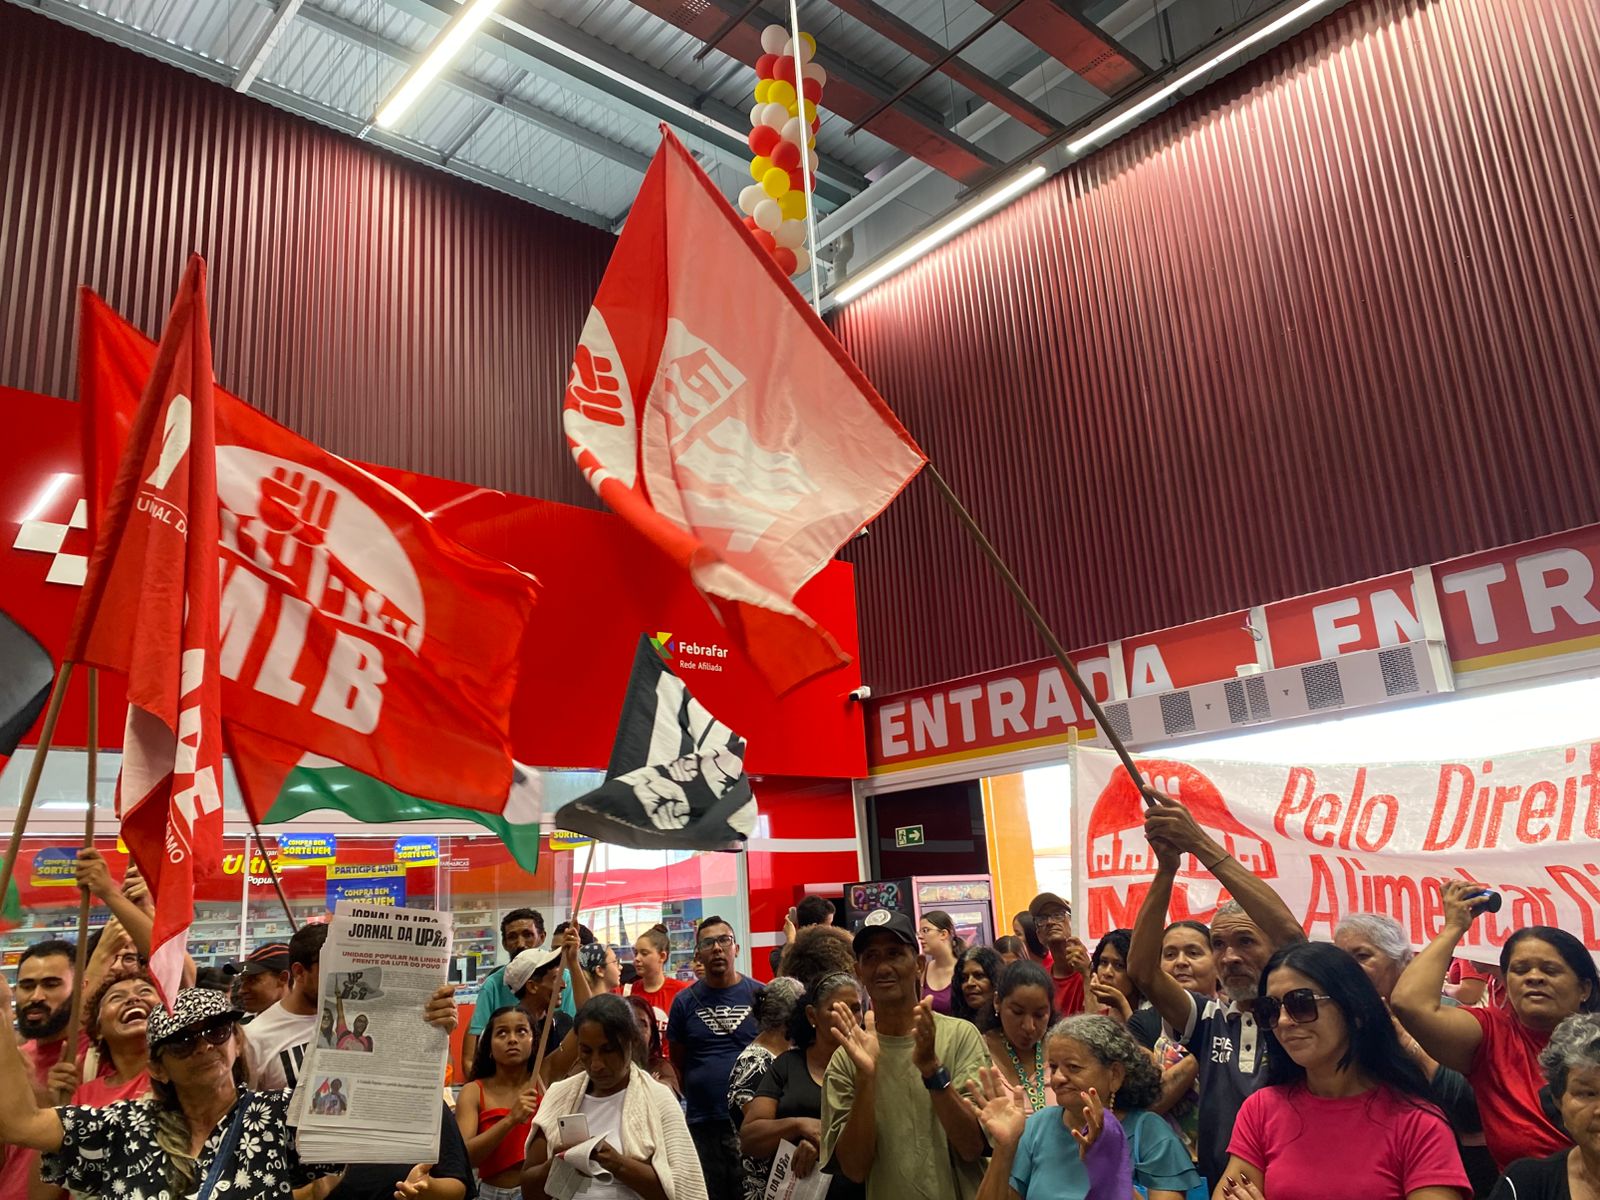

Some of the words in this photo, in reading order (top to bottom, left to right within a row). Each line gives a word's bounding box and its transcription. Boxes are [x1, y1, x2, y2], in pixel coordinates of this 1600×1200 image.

[679, 641, 728, 658] Febrafar
[680, 660, 696, 669] Rede
[698, 661, 722, 672] Afiliada
[1274, 766, 1399, 852] Pelo
[283, 847, 312, 855] SORTE
[312, 846, 332, 855] VEM
[334, 865, 376, 874] PARTICIPE
[377, 864, 398, 874] AQUI
[344, 888, 373, 897] COMPRA
[374, 887, 389, 895] BEM
[348, 923, 393, 940] JORNAL
[397, 926, 413, 942] DA
[342, 951, 373, 959] UNIDADE
[375, 953, 408, 961] POPULAR
